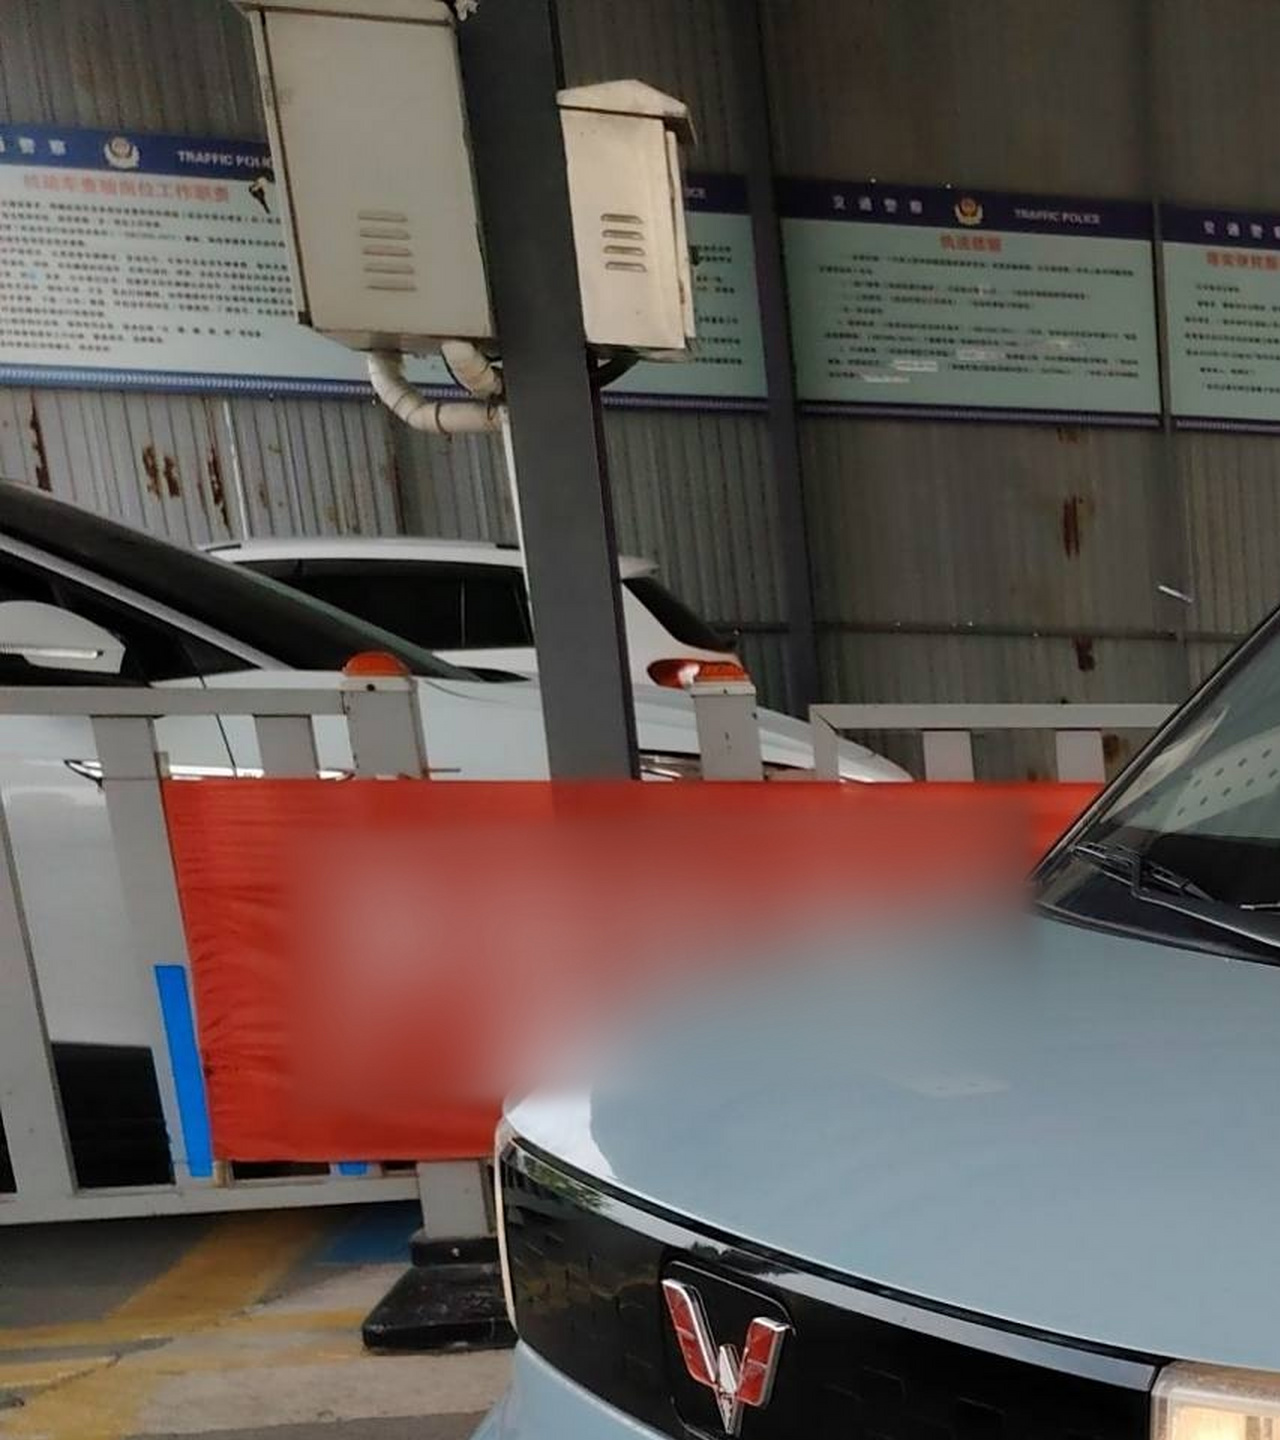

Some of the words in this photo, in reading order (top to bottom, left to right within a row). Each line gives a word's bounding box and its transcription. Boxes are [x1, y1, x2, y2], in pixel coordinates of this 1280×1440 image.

[176, 150, 233, 167] TRAFFIC
[236, 154, 274, 169] POLIC
[1013, 208, 1061, 223] TRAFFIC
[1063, 212, 1101, 225] POLICE
